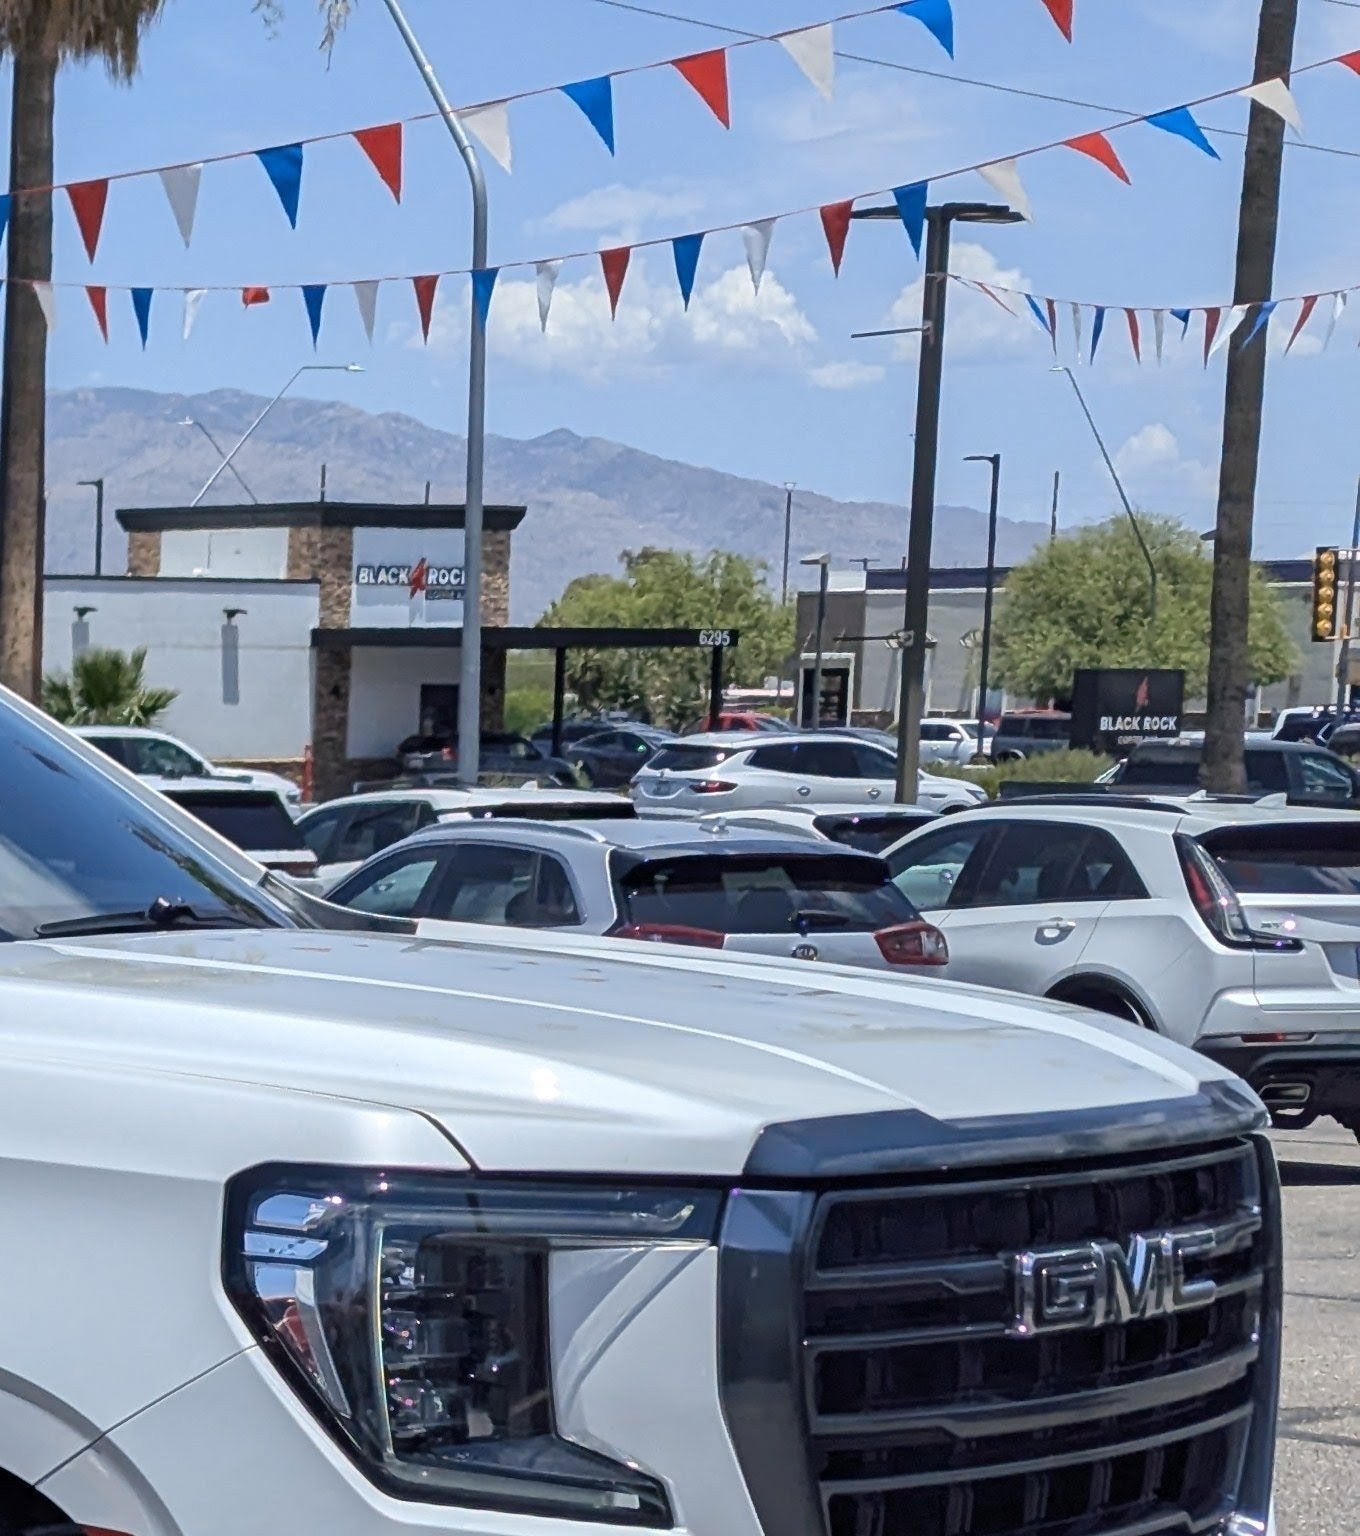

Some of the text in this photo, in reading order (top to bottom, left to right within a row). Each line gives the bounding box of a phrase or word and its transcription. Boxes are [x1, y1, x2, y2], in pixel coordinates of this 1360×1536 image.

[358, 567, 409, 585] BLACK
[699, 629, 730, 646] 6295
[1099, 715, 1177, 731] BLACK ROCK
[1015, 1230, 1217, 1336] GMC
